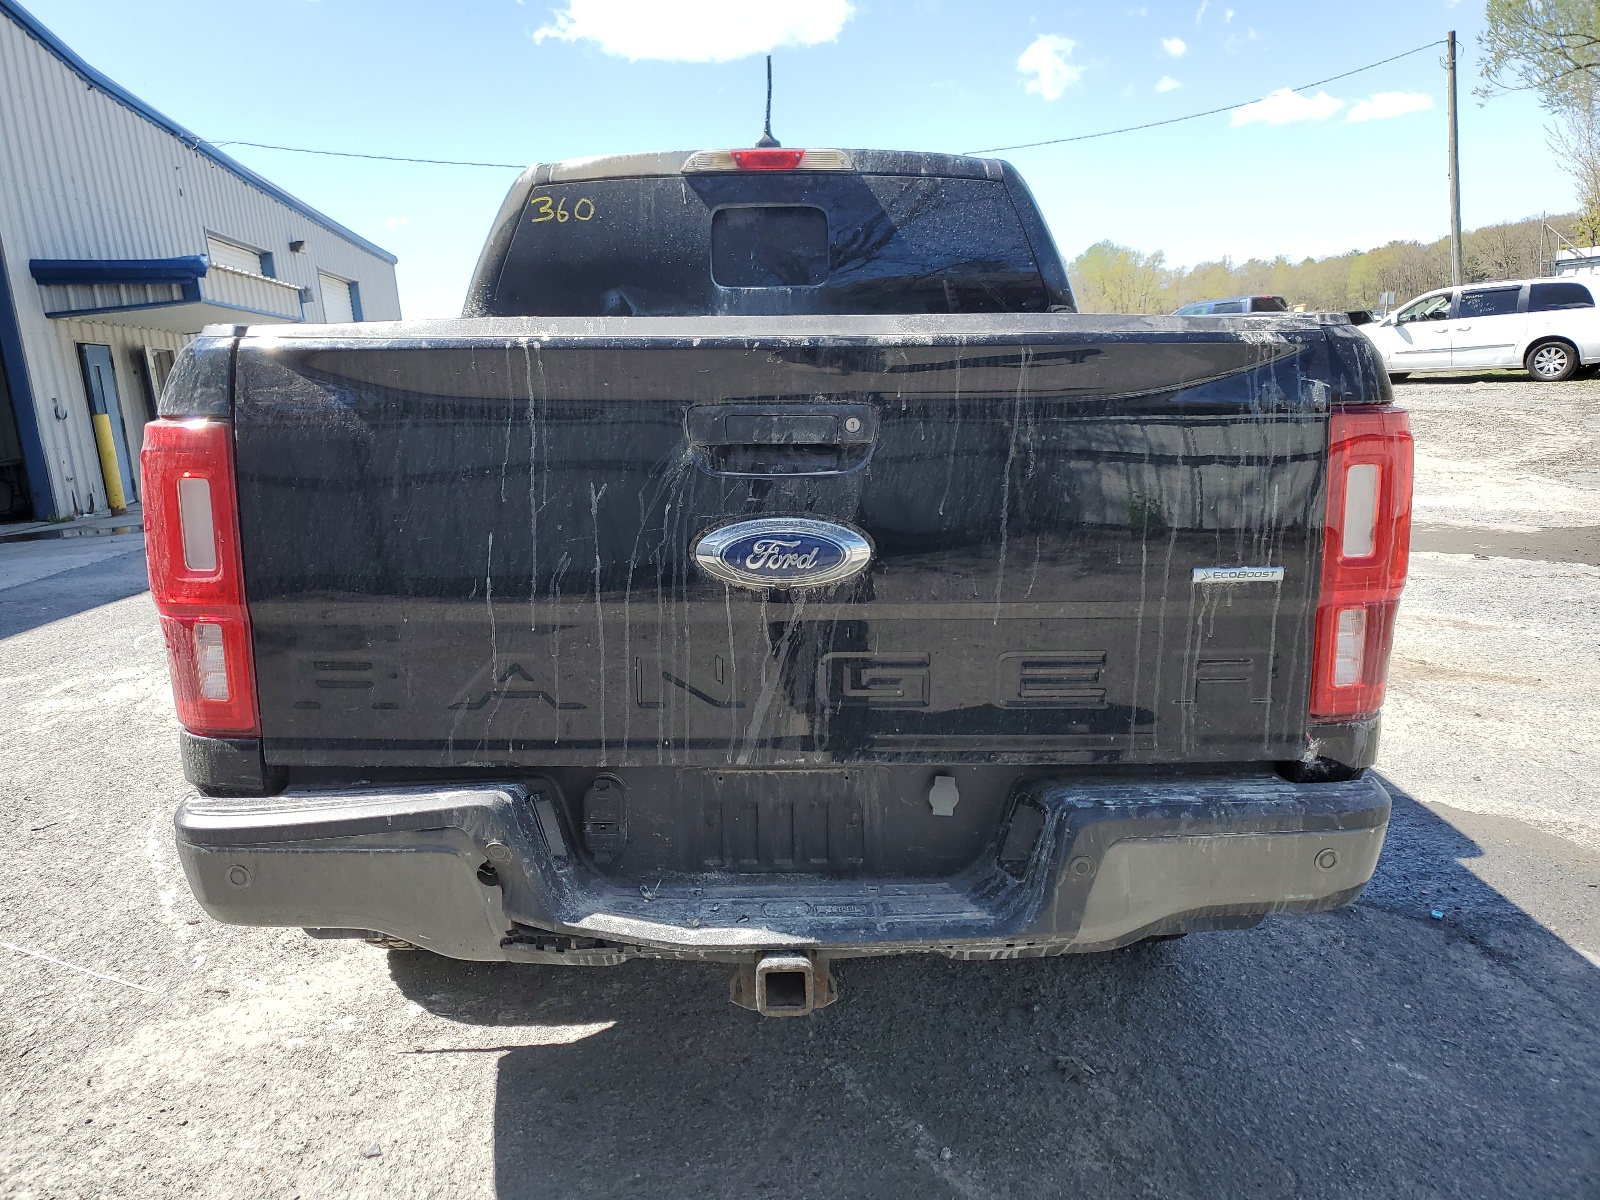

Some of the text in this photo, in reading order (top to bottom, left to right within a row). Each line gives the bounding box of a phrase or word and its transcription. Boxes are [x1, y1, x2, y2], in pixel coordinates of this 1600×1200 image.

[531, 196, 595, 222] 360
[745, 539, 820, 570] Ford
[1213, 571, 1277, 579] ECOBOOST
[291, 649, 1278, 710] RANGER
